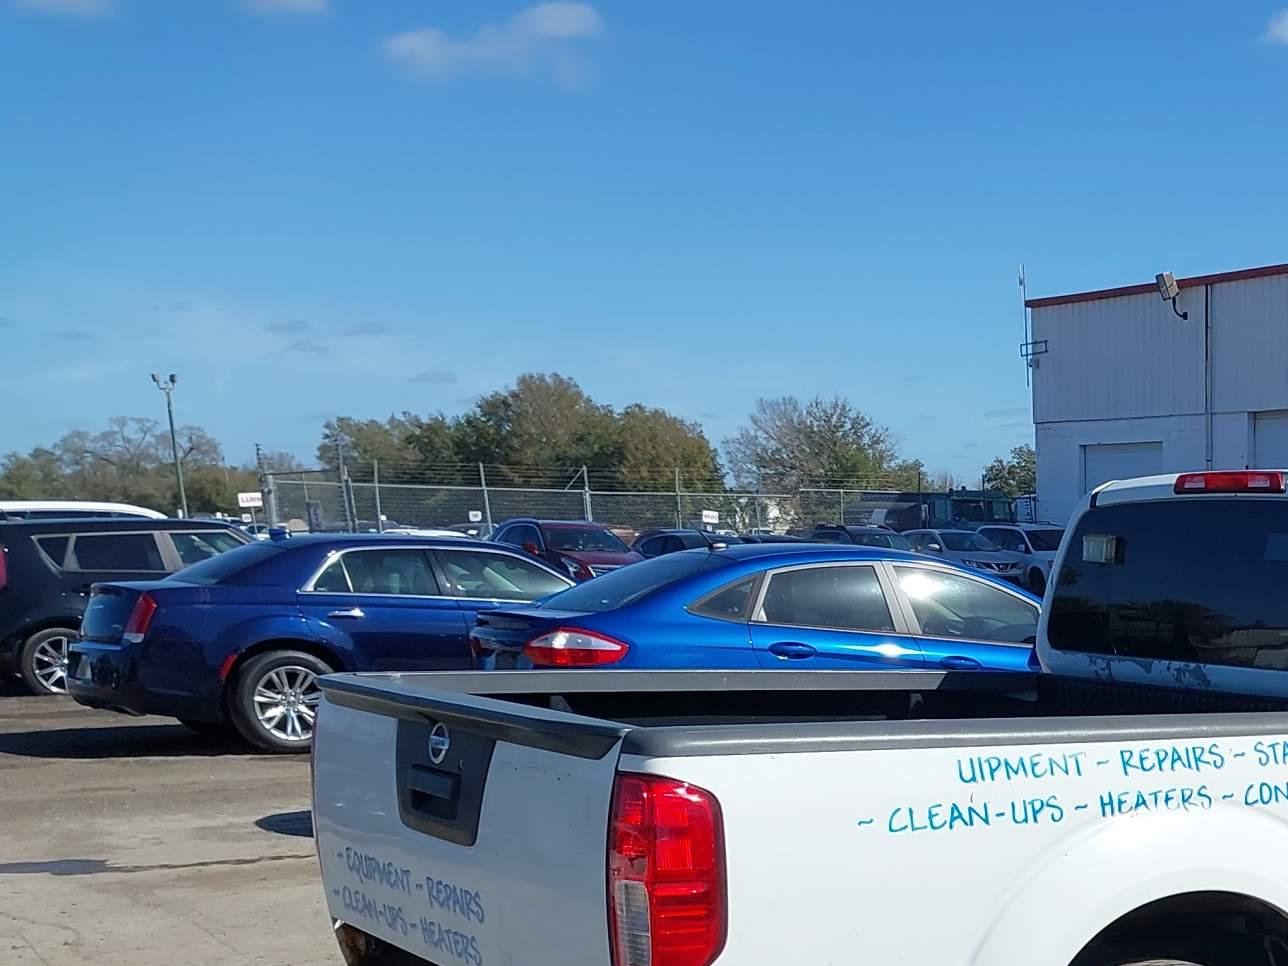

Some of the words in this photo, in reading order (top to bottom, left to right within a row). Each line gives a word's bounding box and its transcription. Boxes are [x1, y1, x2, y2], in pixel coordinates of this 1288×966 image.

[956, 751, 1084, 784] UIPMENT
[1120, 743, 1226, 776] REPAIRS
[887, 795, 1065, 834] CLEAN-UPS
[1099, 785, 1213, 818] HEATERS
[345, 846, 412, 896] EQUIPMENT
[425, 875, 485, 924] REPAIRS
[341, 885, 408, 936] CLEAN-UPS
